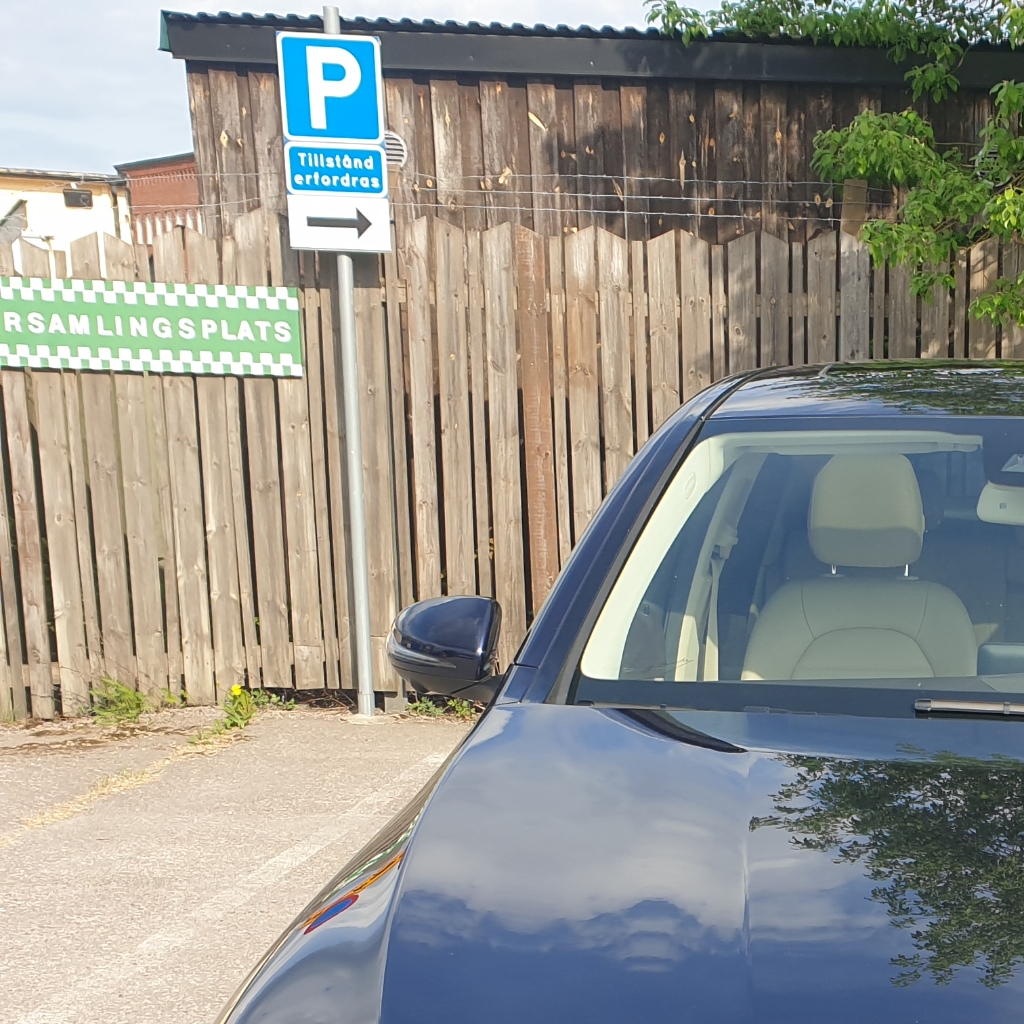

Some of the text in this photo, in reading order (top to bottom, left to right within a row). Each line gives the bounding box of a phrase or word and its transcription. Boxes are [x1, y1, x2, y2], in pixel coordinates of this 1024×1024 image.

[306, 45, 362, 130] P
[297, 153, 374, 170] Tillstånd
[293, 173, 380, 189] erfordras
[3, 311, 292, 343] RSAMLINGSPLATS
